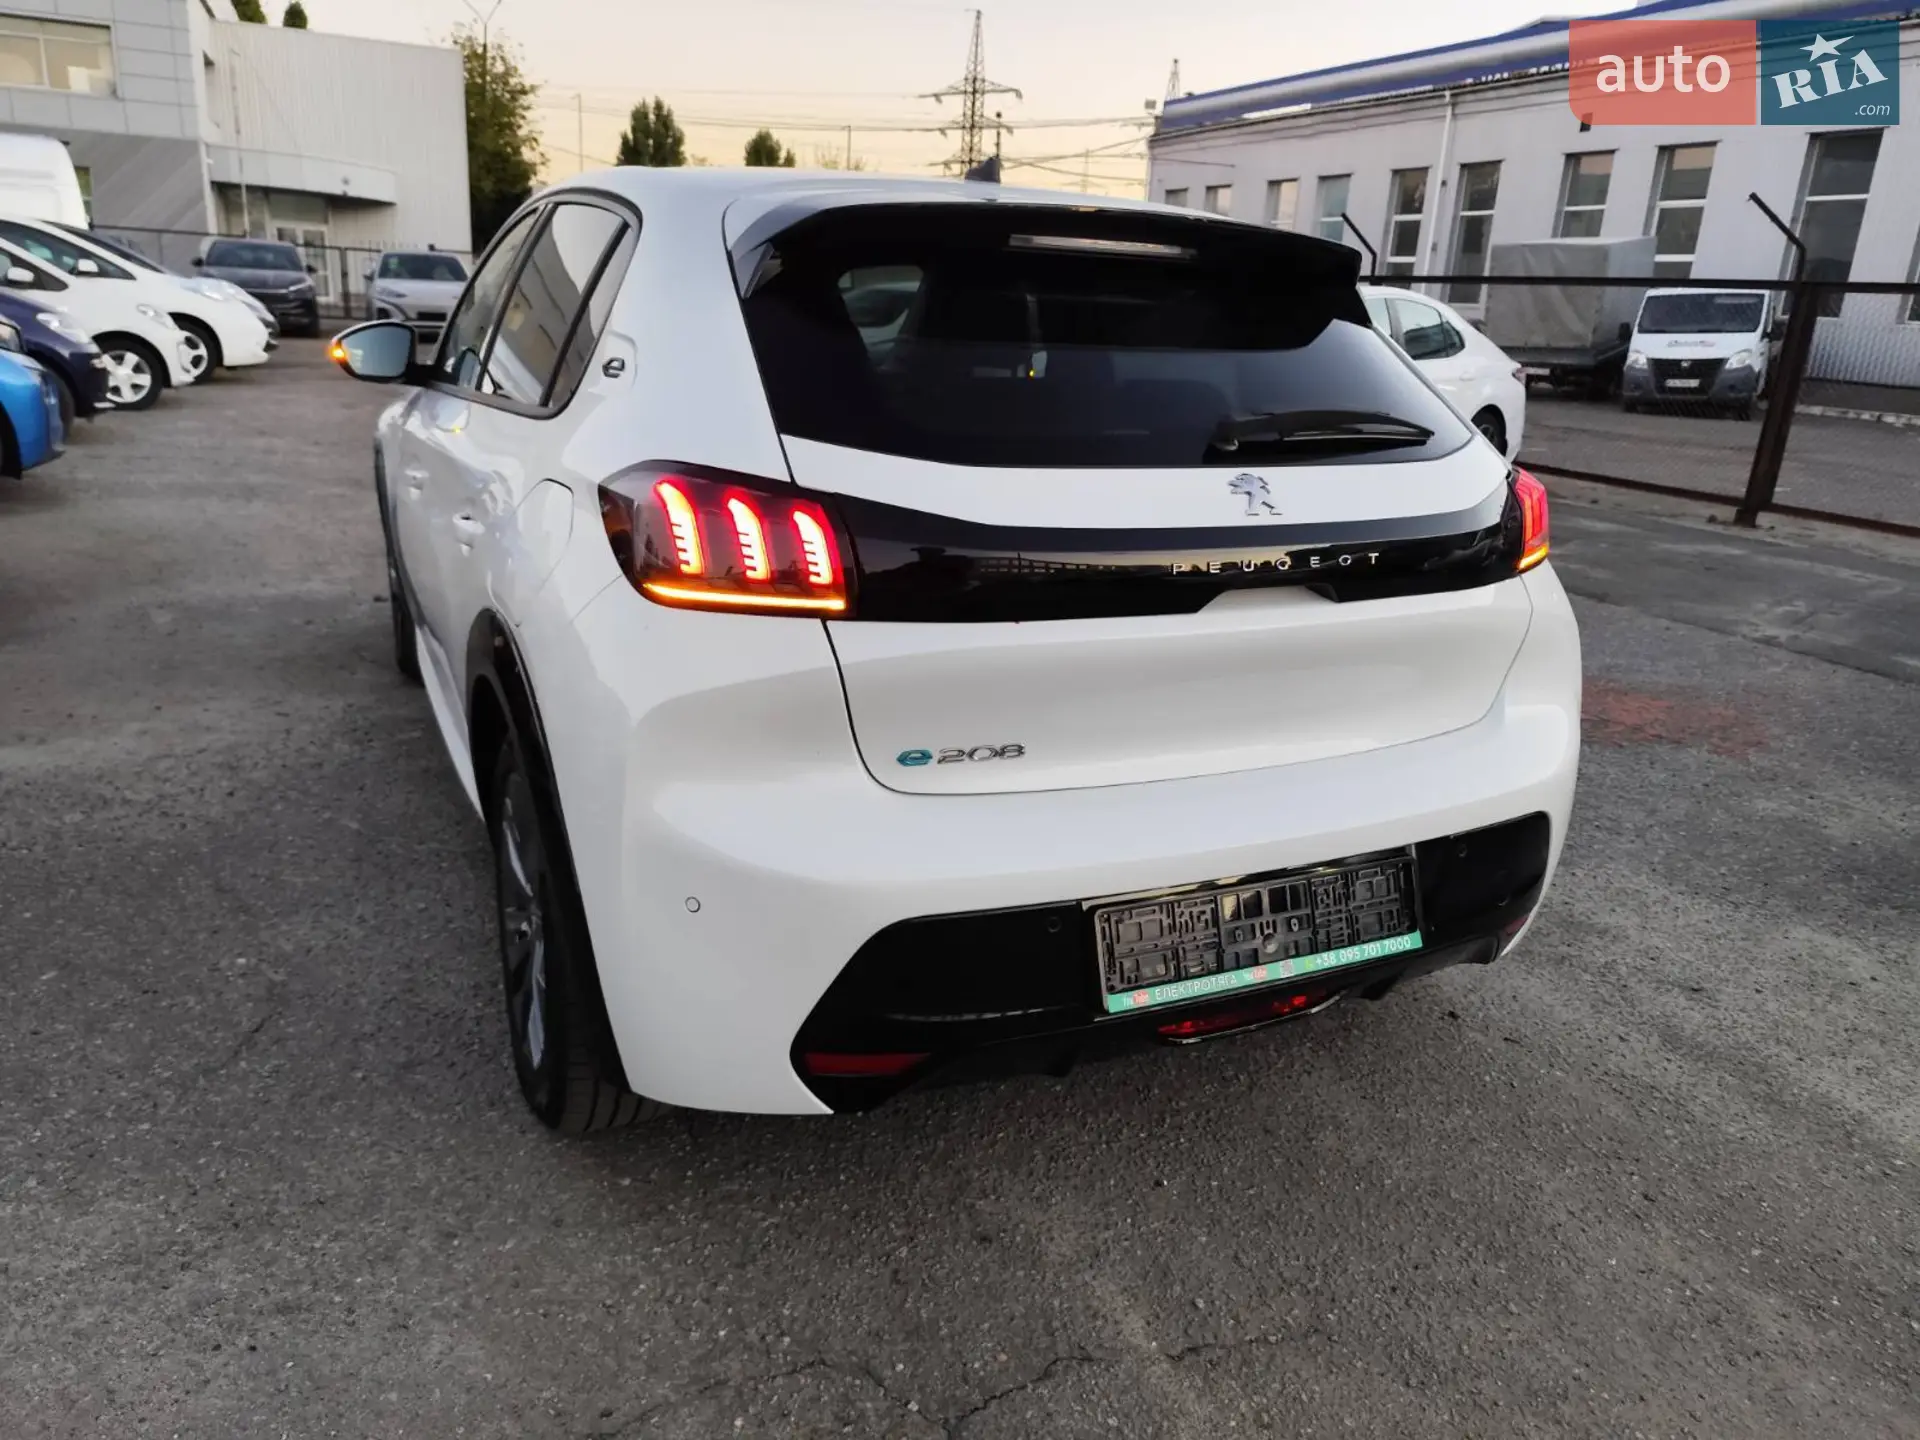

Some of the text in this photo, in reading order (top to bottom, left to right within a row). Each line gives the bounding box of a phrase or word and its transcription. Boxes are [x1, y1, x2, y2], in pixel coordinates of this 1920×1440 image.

[1172, 552, 1379, 576] PEUGEOT
[1315, 936, 1412, 968] +38 095 701 7000
